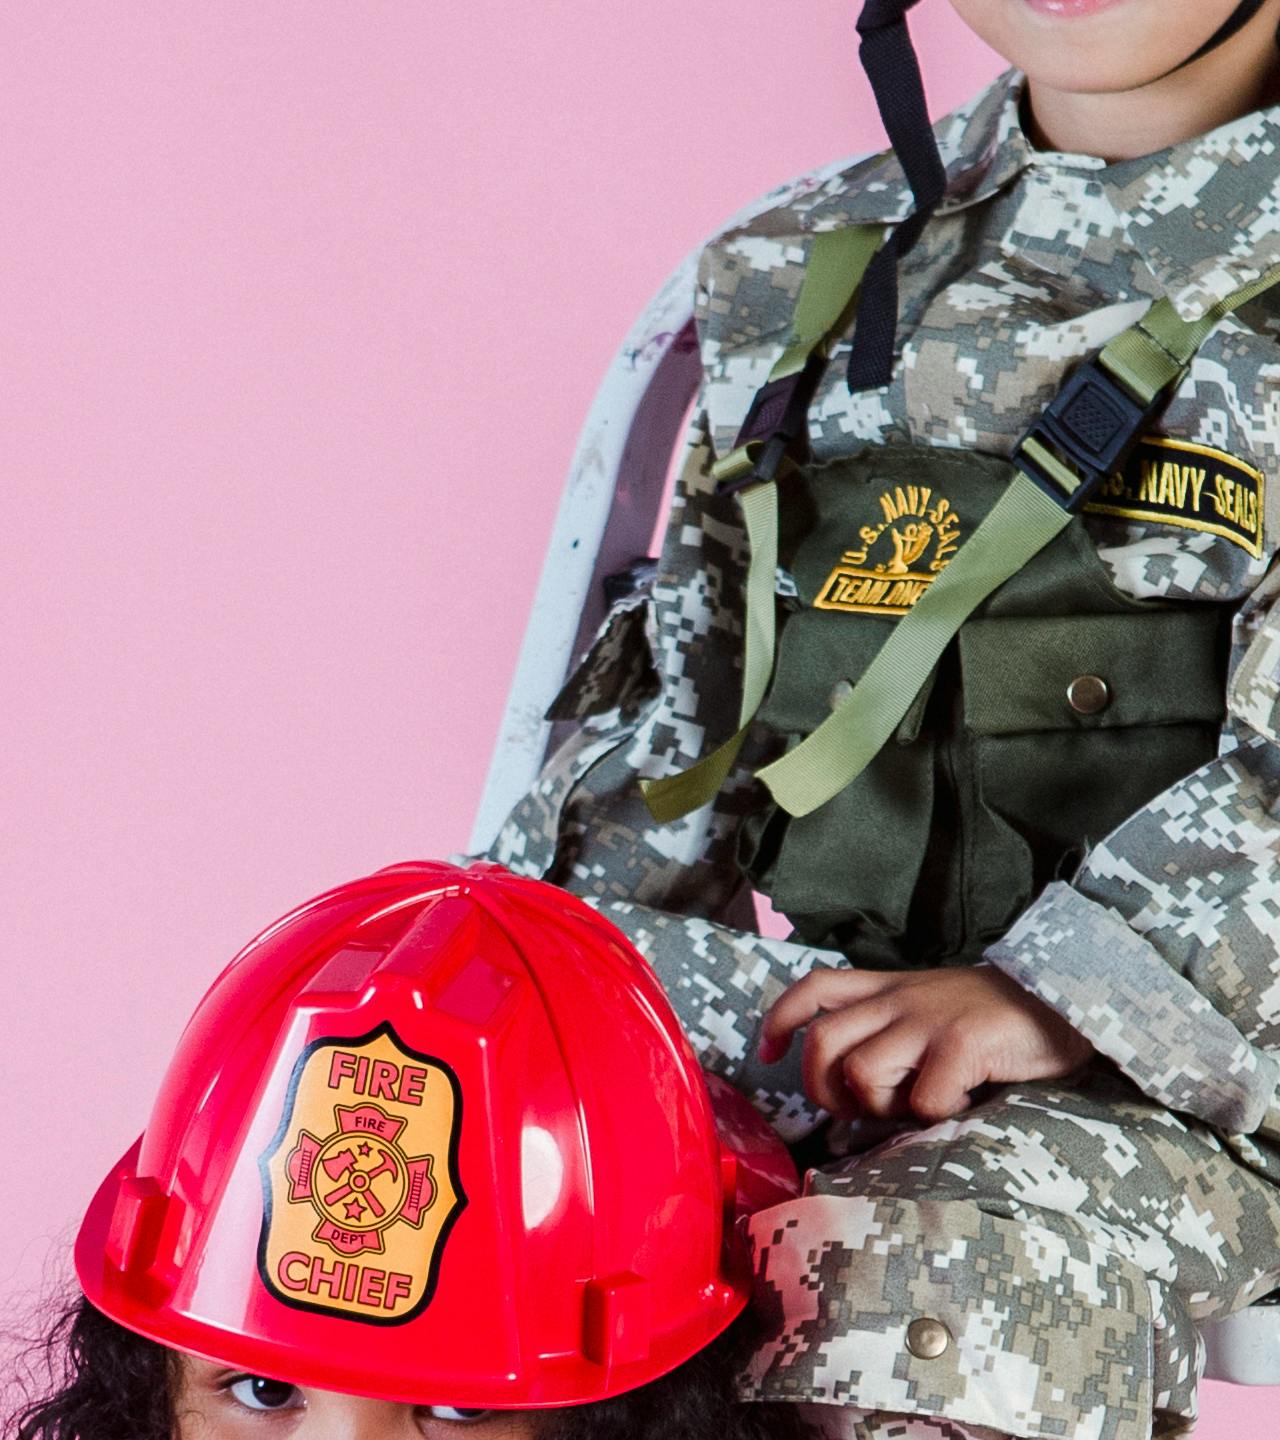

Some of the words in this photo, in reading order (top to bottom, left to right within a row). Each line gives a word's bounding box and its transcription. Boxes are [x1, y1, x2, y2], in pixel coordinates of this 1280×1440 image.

[879, 485, 932, 524] NAVY
[1139, 460, 1207, 513] NAVY
[1213, 473, 1258, 535] SEALS
[830, 576, 891, 605] TEAM
[327, 1050, 428, 1106] FIRE
[354, 1115, 387, 1133] FIRE
[330, 1228, 367, 1246] DEPT
[277, 1250, 414, 1311] CHIEF
